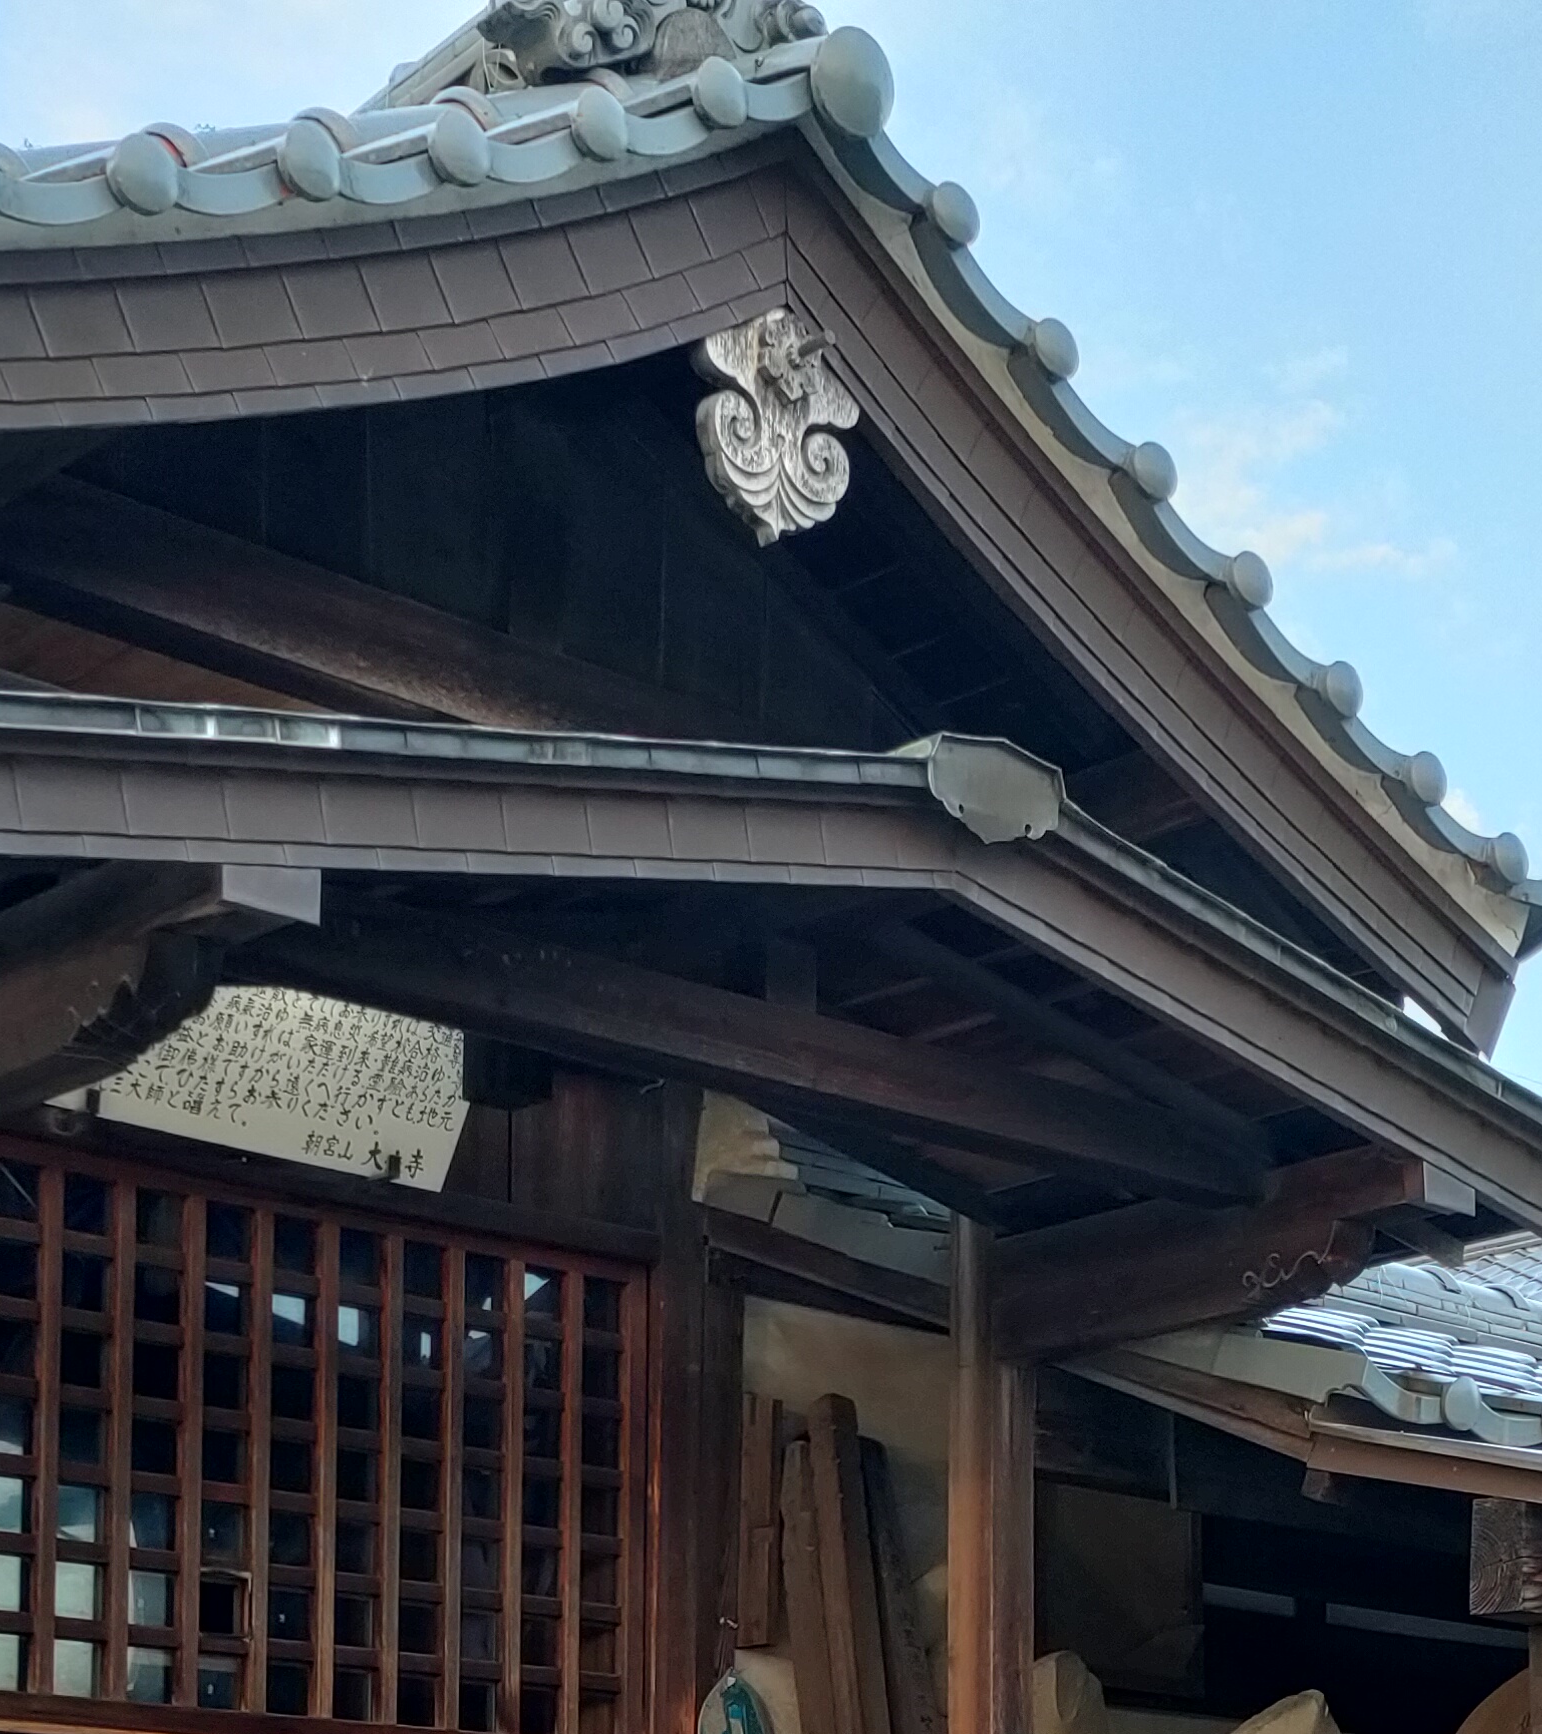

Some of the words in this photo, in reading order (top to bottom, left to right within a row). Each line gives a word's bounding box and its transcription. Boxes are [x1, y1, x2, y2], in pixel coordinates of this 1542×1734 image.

[300, 1128, 358, 1161] 朝宮山
[360, 1137, 430, 1181] 大寺
